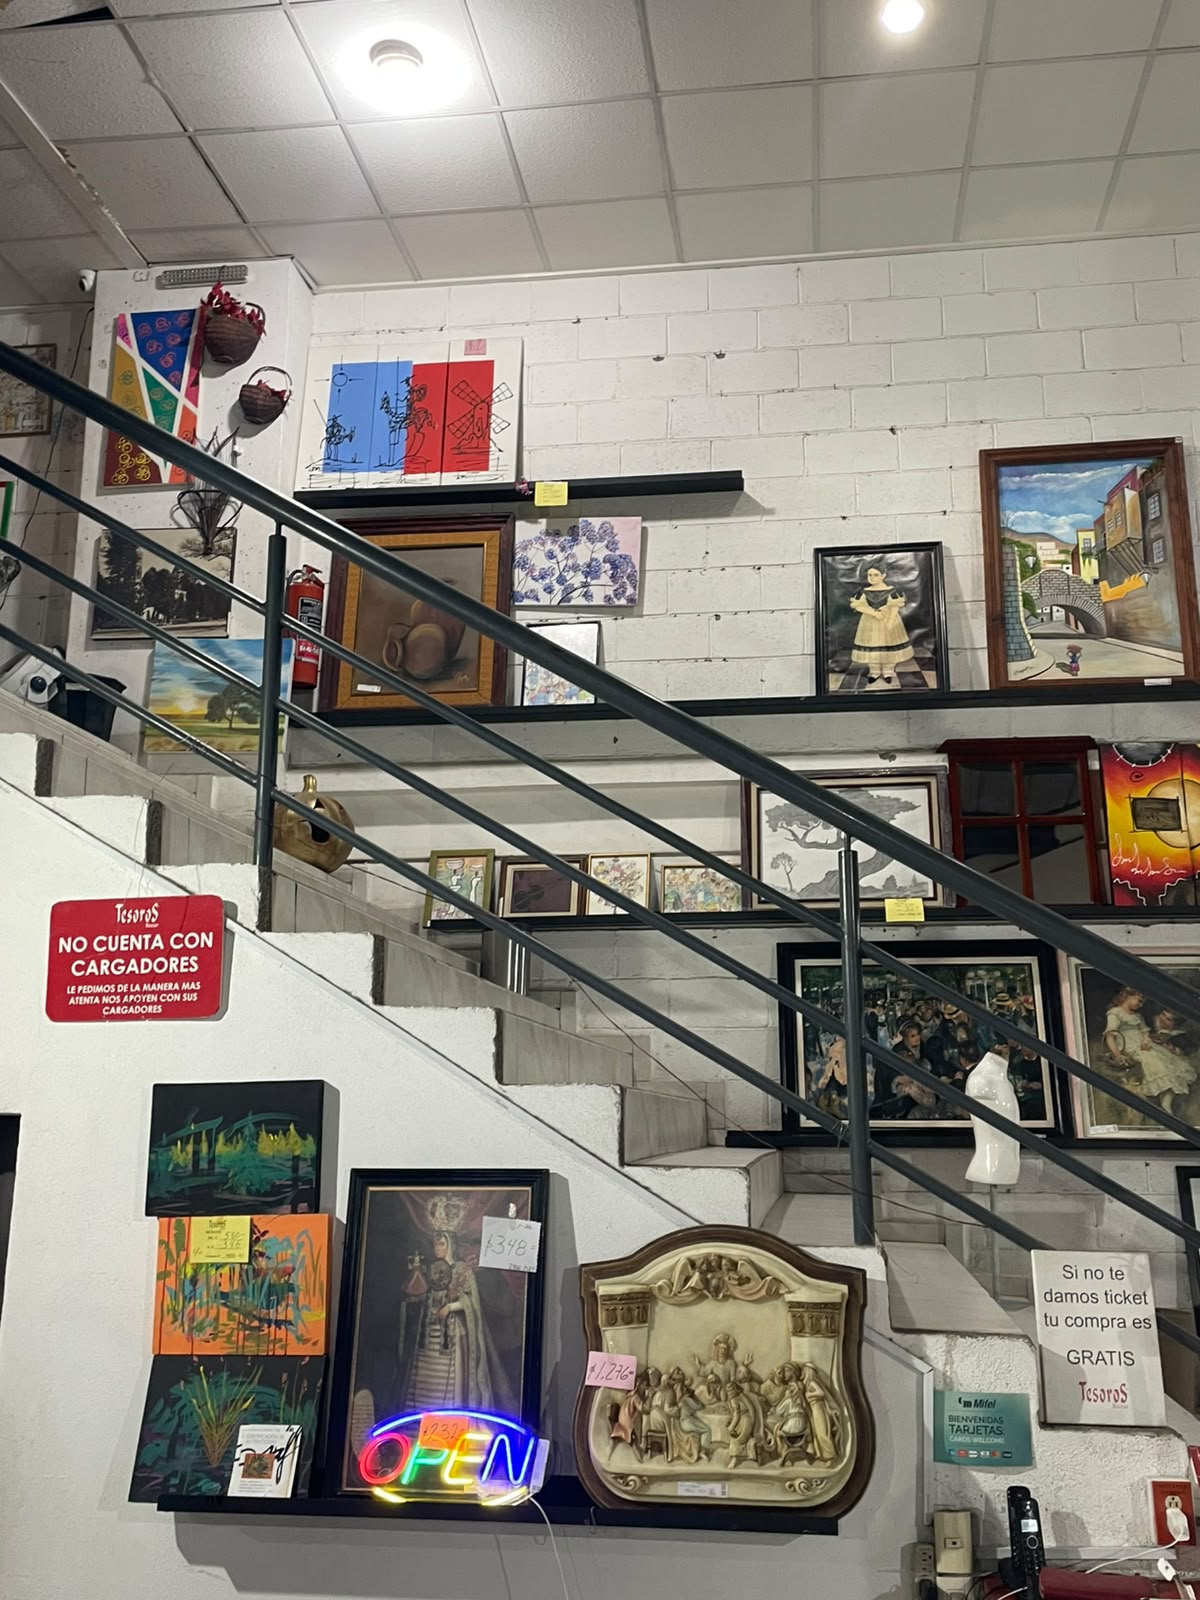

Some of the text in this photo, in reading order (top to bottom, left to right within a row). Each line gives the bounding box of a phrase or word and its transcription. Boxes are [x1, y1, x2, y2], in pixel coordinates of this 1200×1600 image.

[58, 932, 213, 953] NO CUENTA CON
[71, 956, 199, 976] CARGADORES
[67, 982, 200, 994] LE PEDIMOS DE LA MANERA MAS
[68, 992, 198, 1005] ATENTA NOS APOYEN CON SUS
[102, 1005, 162, 1016] CARGADORES
[1062, 1264, 1125, 1280] Si no te
[1044, 1288, 1149, 1305] damos ticket
[1044, 1312, 1152, 1332] tu compra es
[1066, 1350, 1136, 1366] GRATIS
[948, 1414, 1004, 1424] BIENVENIDAS
[359, 1432, 536, 1486] OPEN
